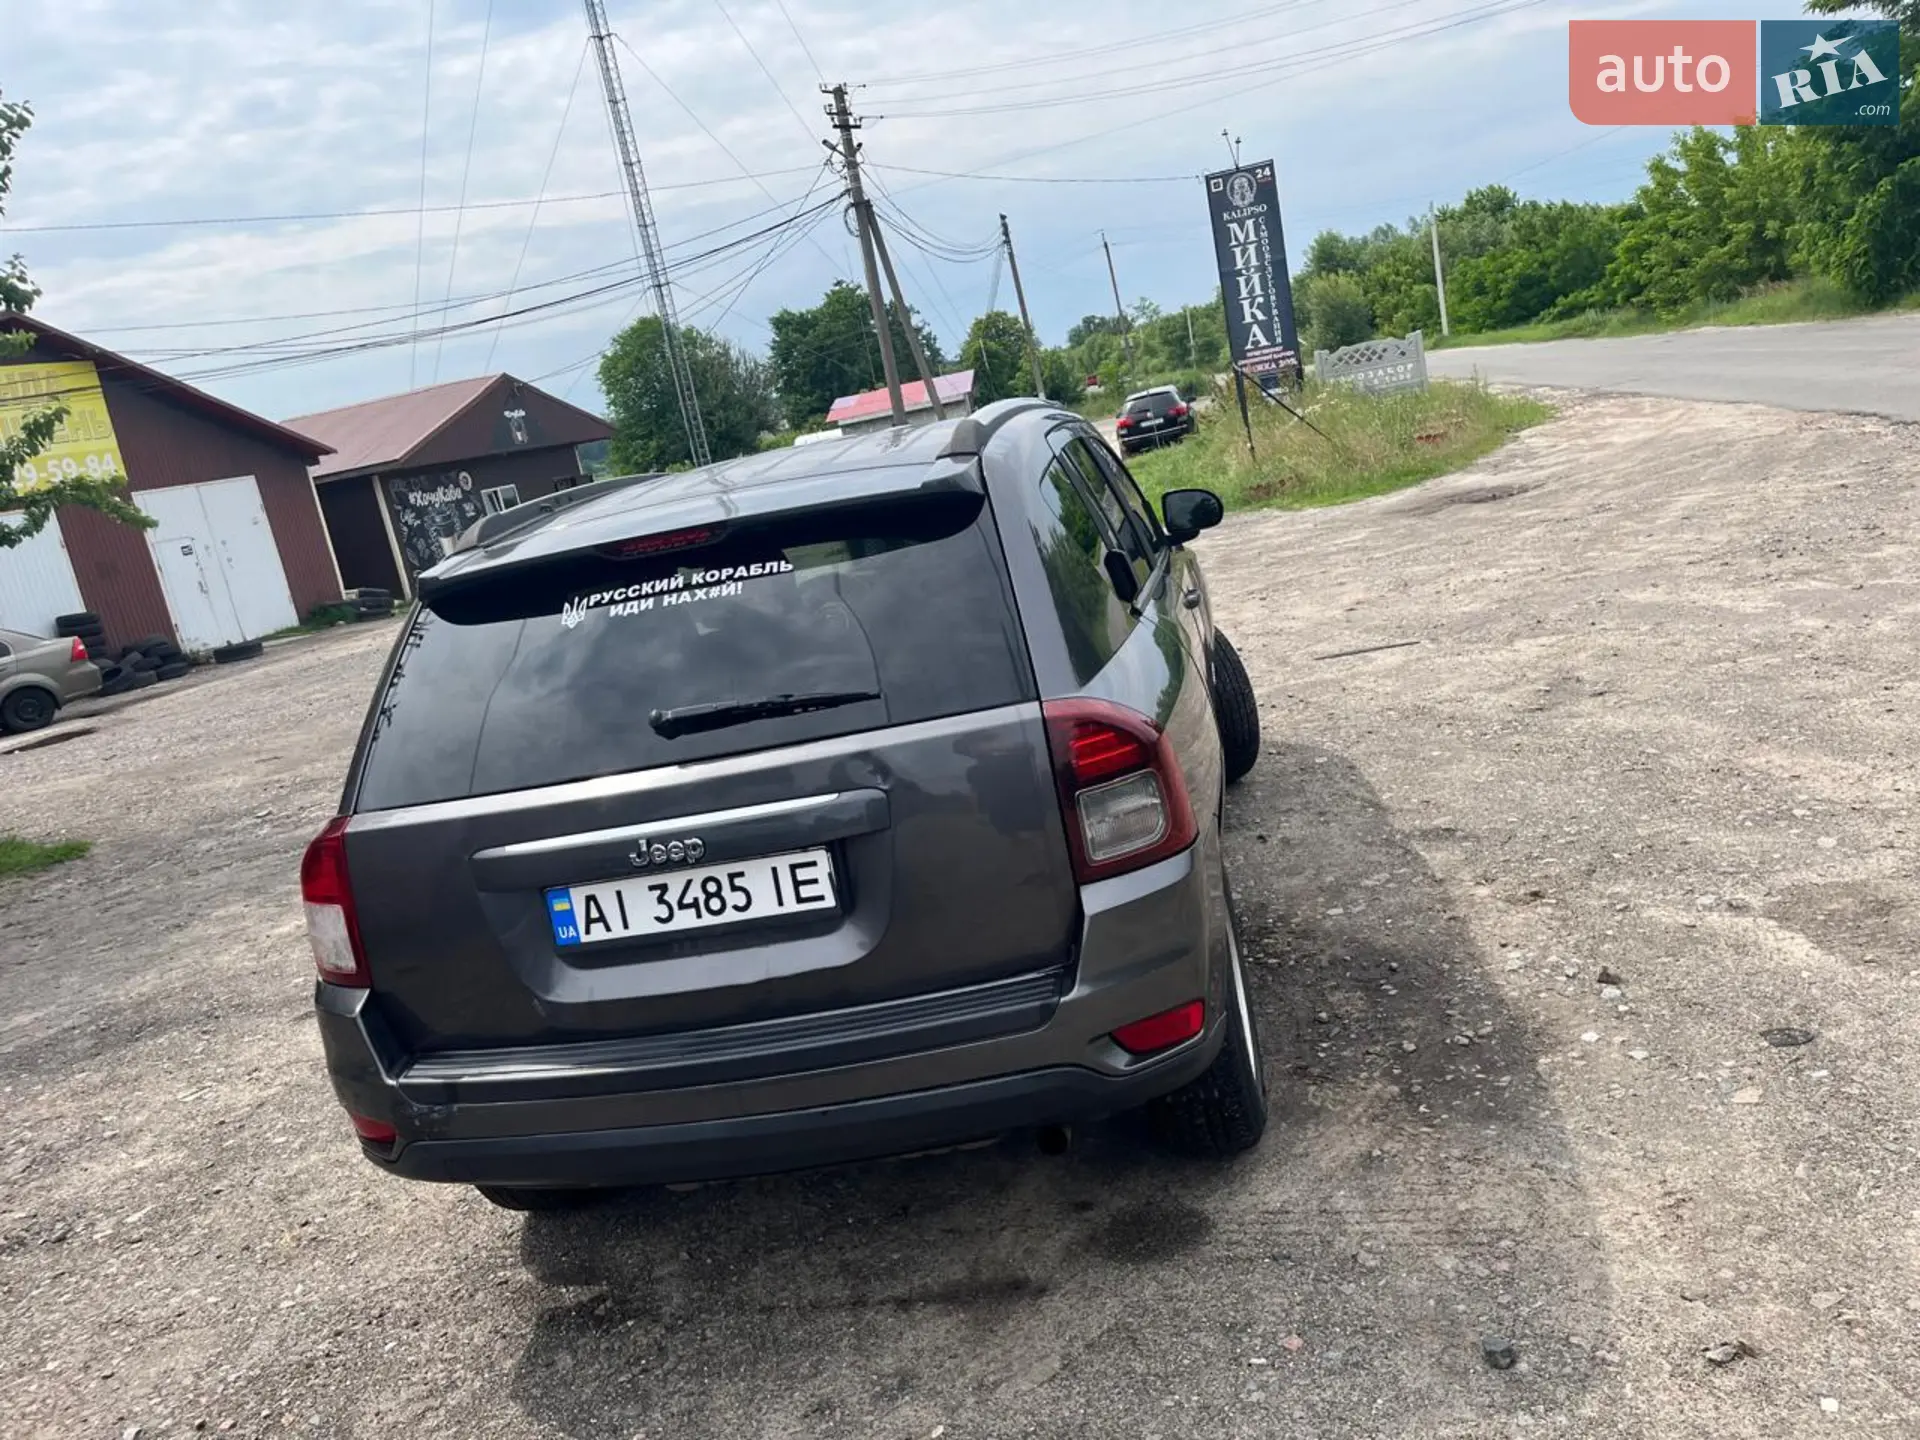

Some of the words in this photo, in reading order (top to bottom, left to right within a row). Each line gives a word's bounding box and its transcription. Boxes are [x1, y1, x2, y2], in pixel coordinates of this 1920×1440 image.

[1255, 166, 1272, 179] 24
[1223, 204, 1268, 221] KALIPSO
[1226, 218, 1272, 350] МИЙКА
[588, 573, 685, 607] РУССКИЙ
[691, 560, 795, 585] КОРАБЛЬ
[609, 597, 655, 617] ИДИ
[662, 580, 743, 607] НАХ#Й!
[629, 837, 705, 867] Jeep
[584, 889, 630, 935] AI
[648, 870, 752, 924] 3485
[771, 860, 826, 907] IE
[558, 926, 577, 938] UA
